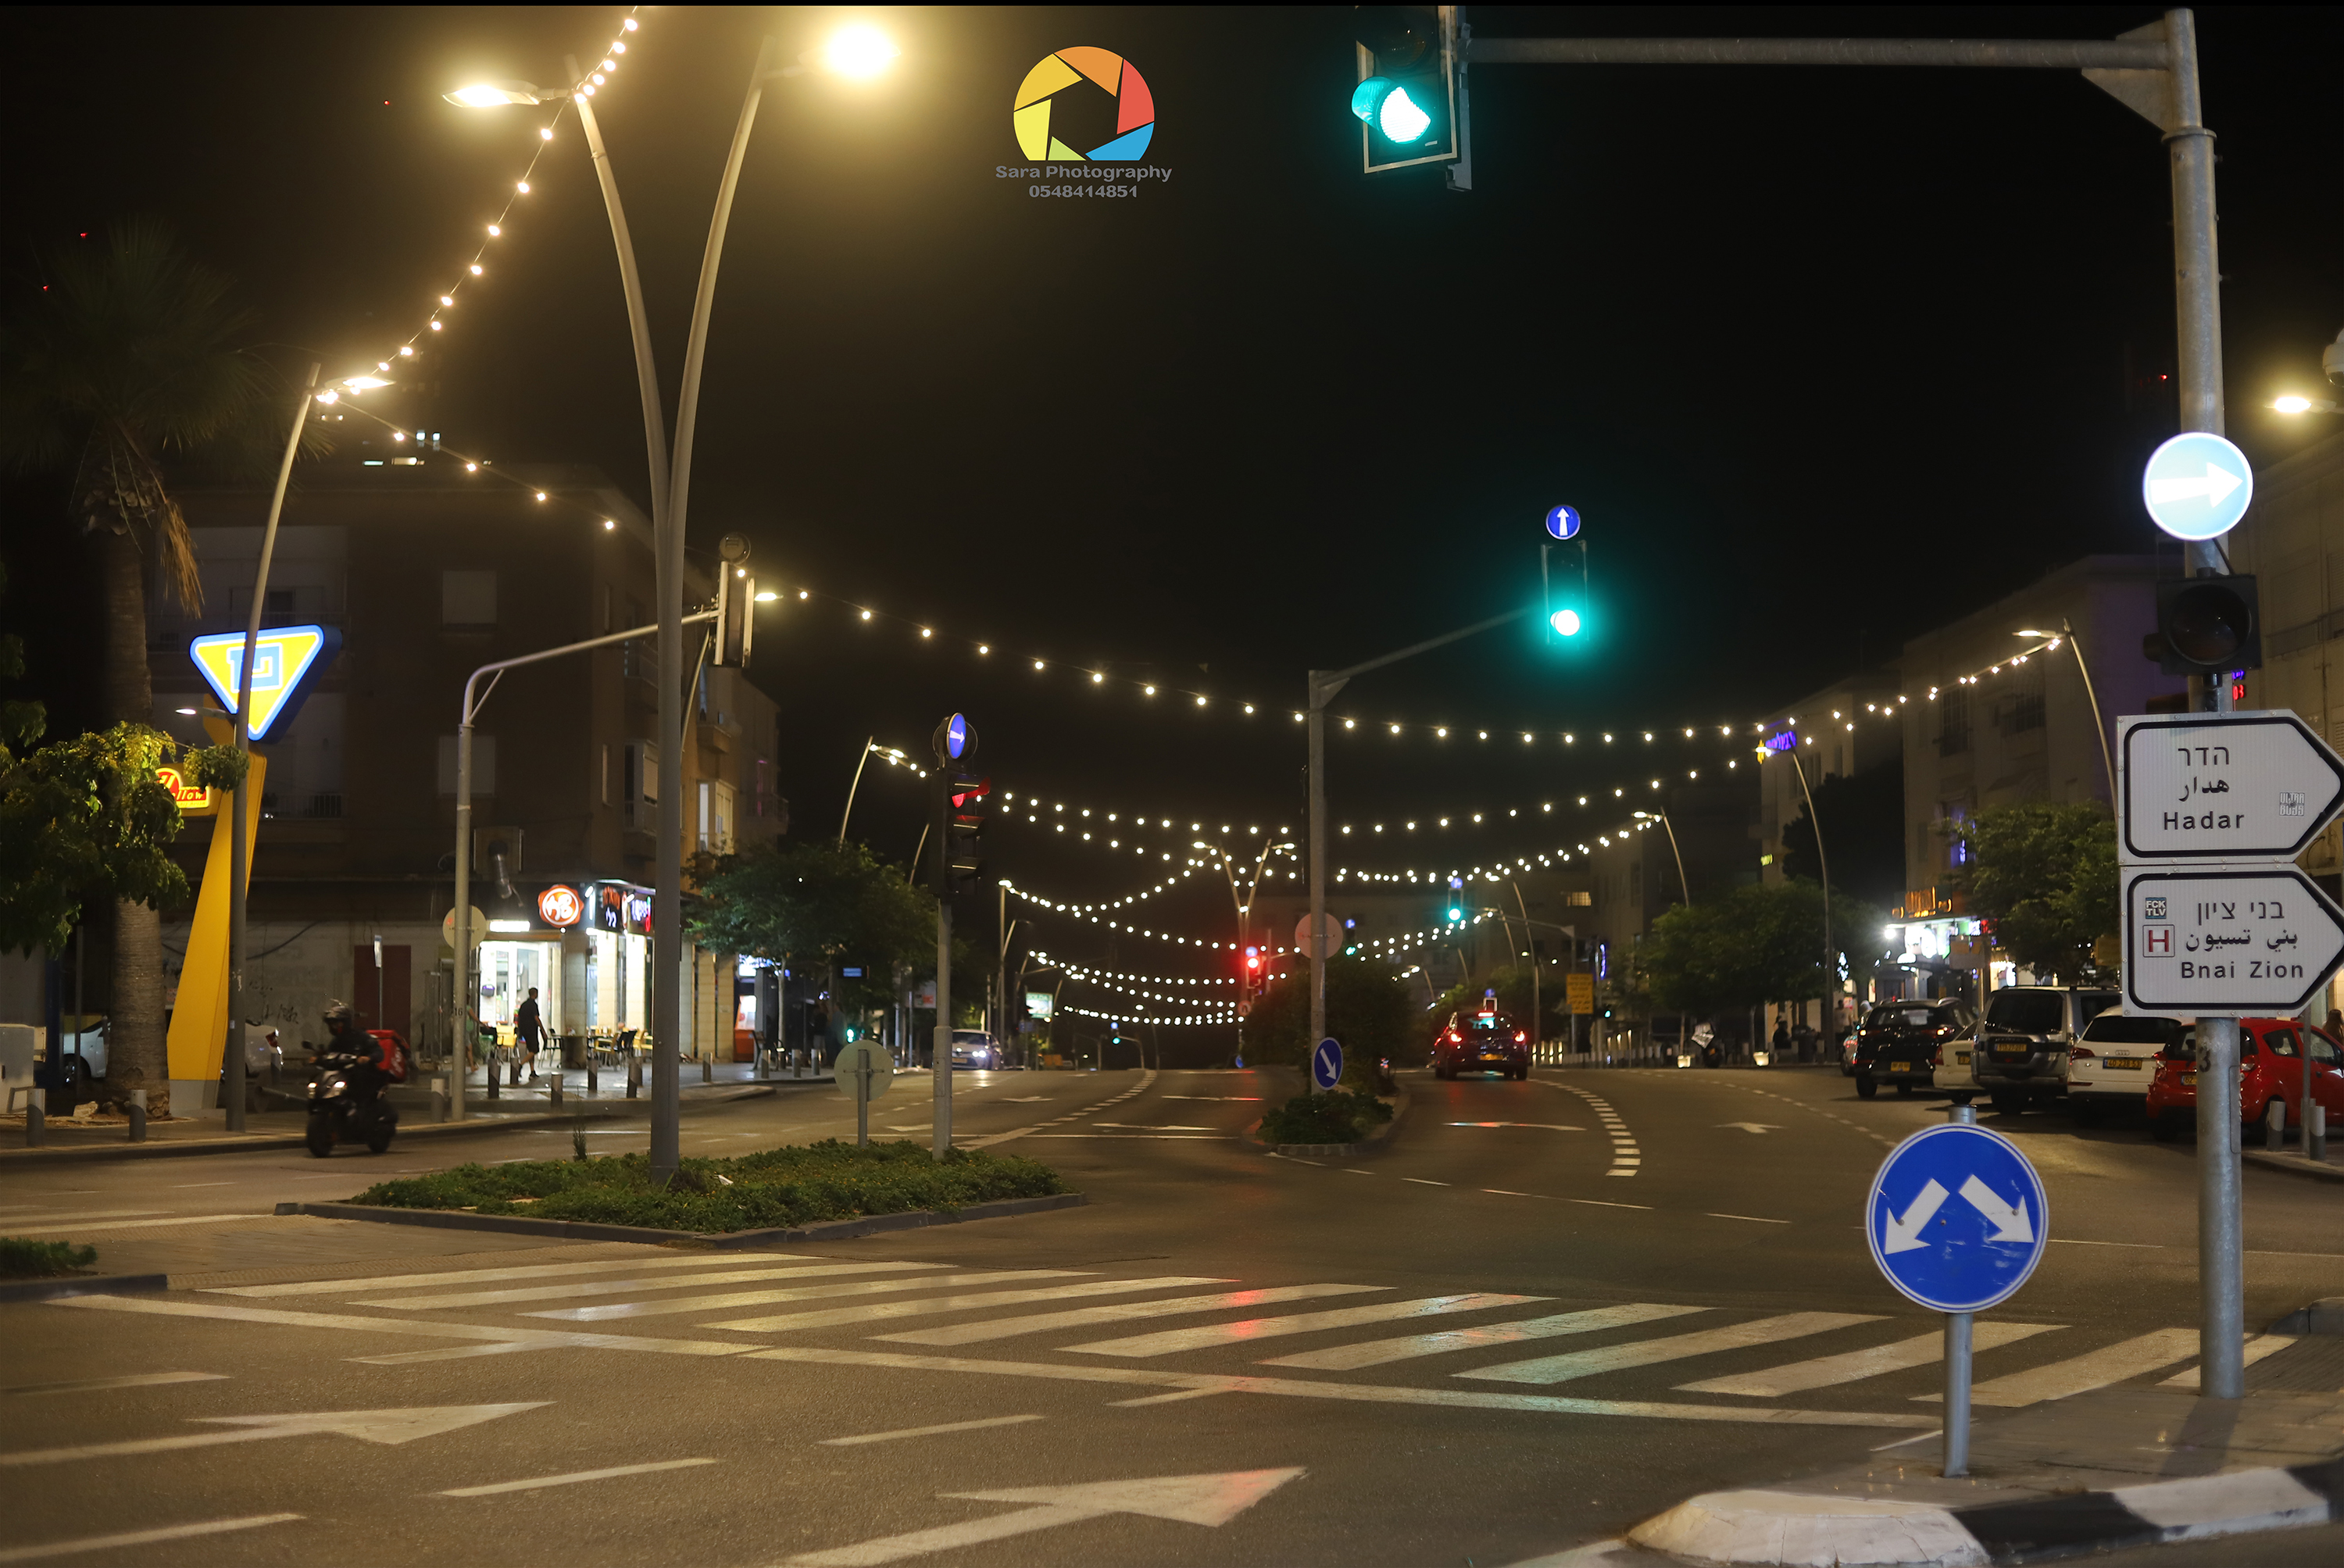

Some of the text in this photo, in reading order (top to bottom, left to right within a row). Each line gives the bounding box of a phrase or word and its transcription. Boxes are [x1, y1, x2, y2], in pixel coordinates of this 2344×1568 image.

[2178, 746, 2229, 766] הדר
[2178, 776, 2230, 802] هدار
[2280, 792, 2305, 804] ULTRA
[2164, 810, 2245, 830] Hadar
[2198, 901, 2285, 926] בני ציון
[2148, 930, 2170, 952] H
[2185, 929, 2298, 952] بني تسيون
[2181, 961, 2303, 978] Bnai Zion
